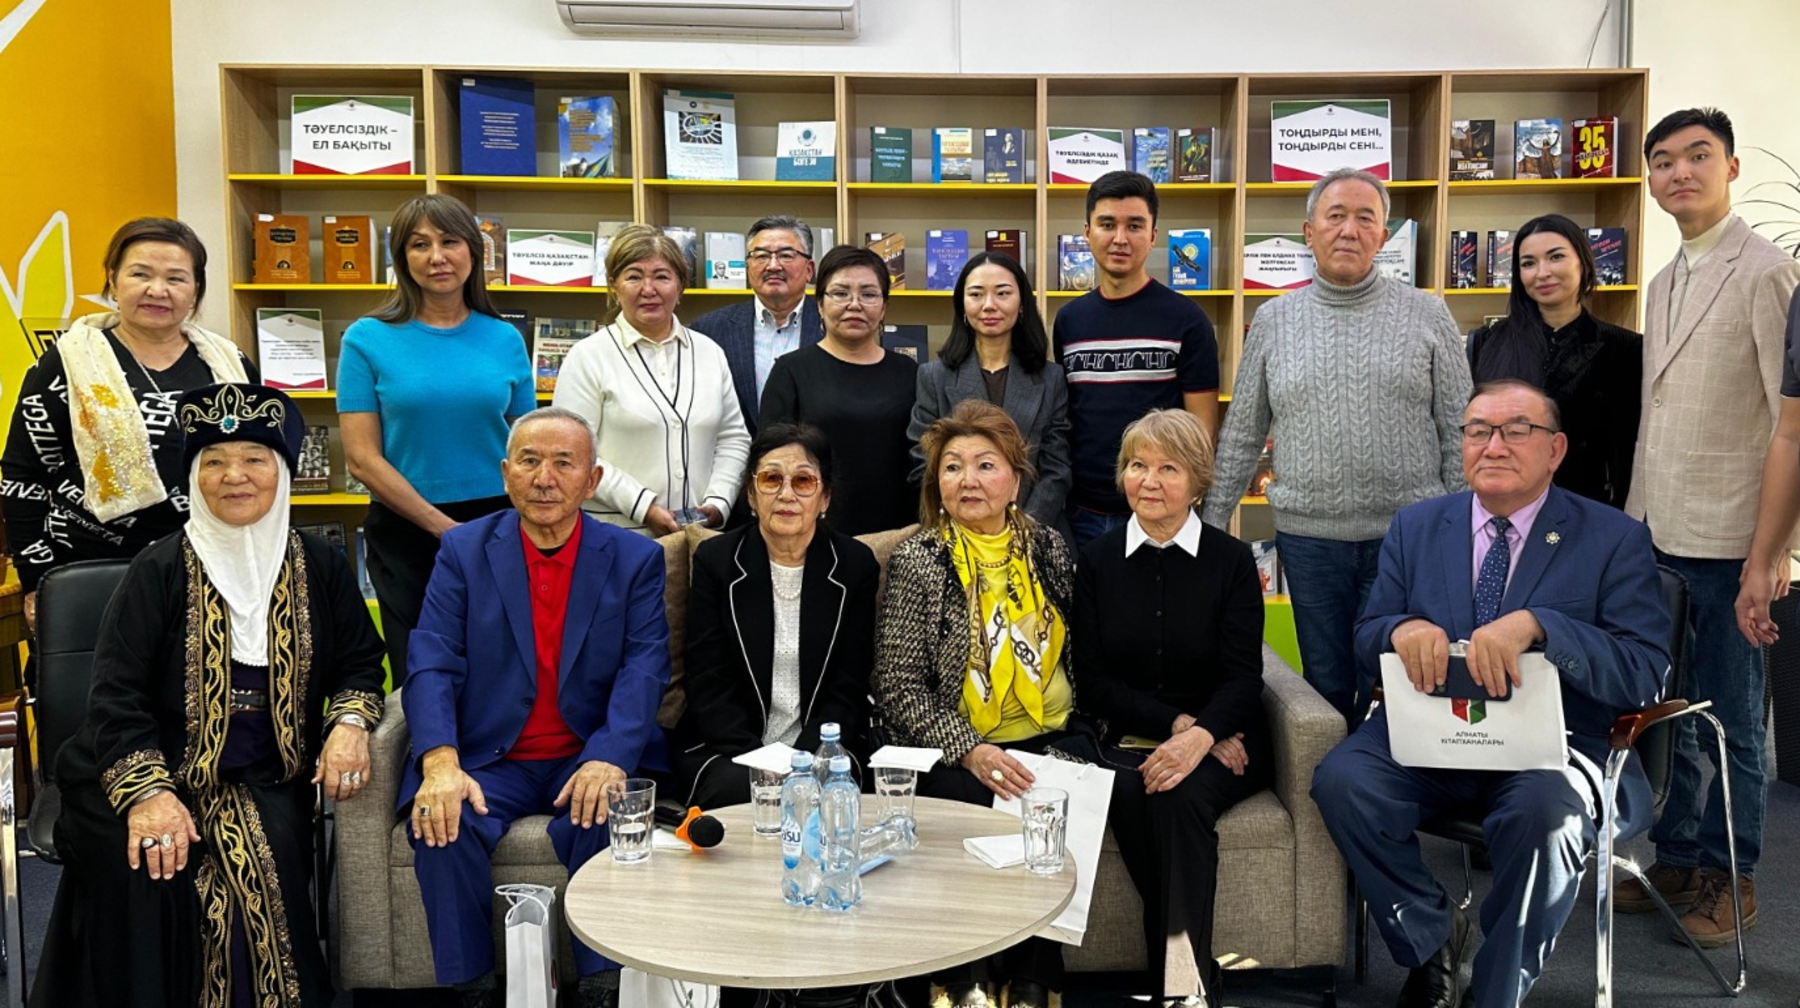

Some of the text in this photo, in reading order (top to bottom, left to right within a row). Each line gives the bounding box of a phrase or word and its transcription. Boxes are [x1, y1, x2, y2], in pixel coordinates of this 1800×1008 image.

[303, 125, 388, 135] ТӘУЕЛСІЗДІК
[1279, 128, 1382, 138] ТОҢДЫРДЫ МЕНІ,
[312, 141, 391, 151] ЕЛ БАҚЫТЫ
[1278, 142, 1347, 152] ТОҢДЫРДЫ
[1579, 125, 1606, 170] 35
[1441, 738, 1505, 746] КІТАПХАНАЛАРЫ
